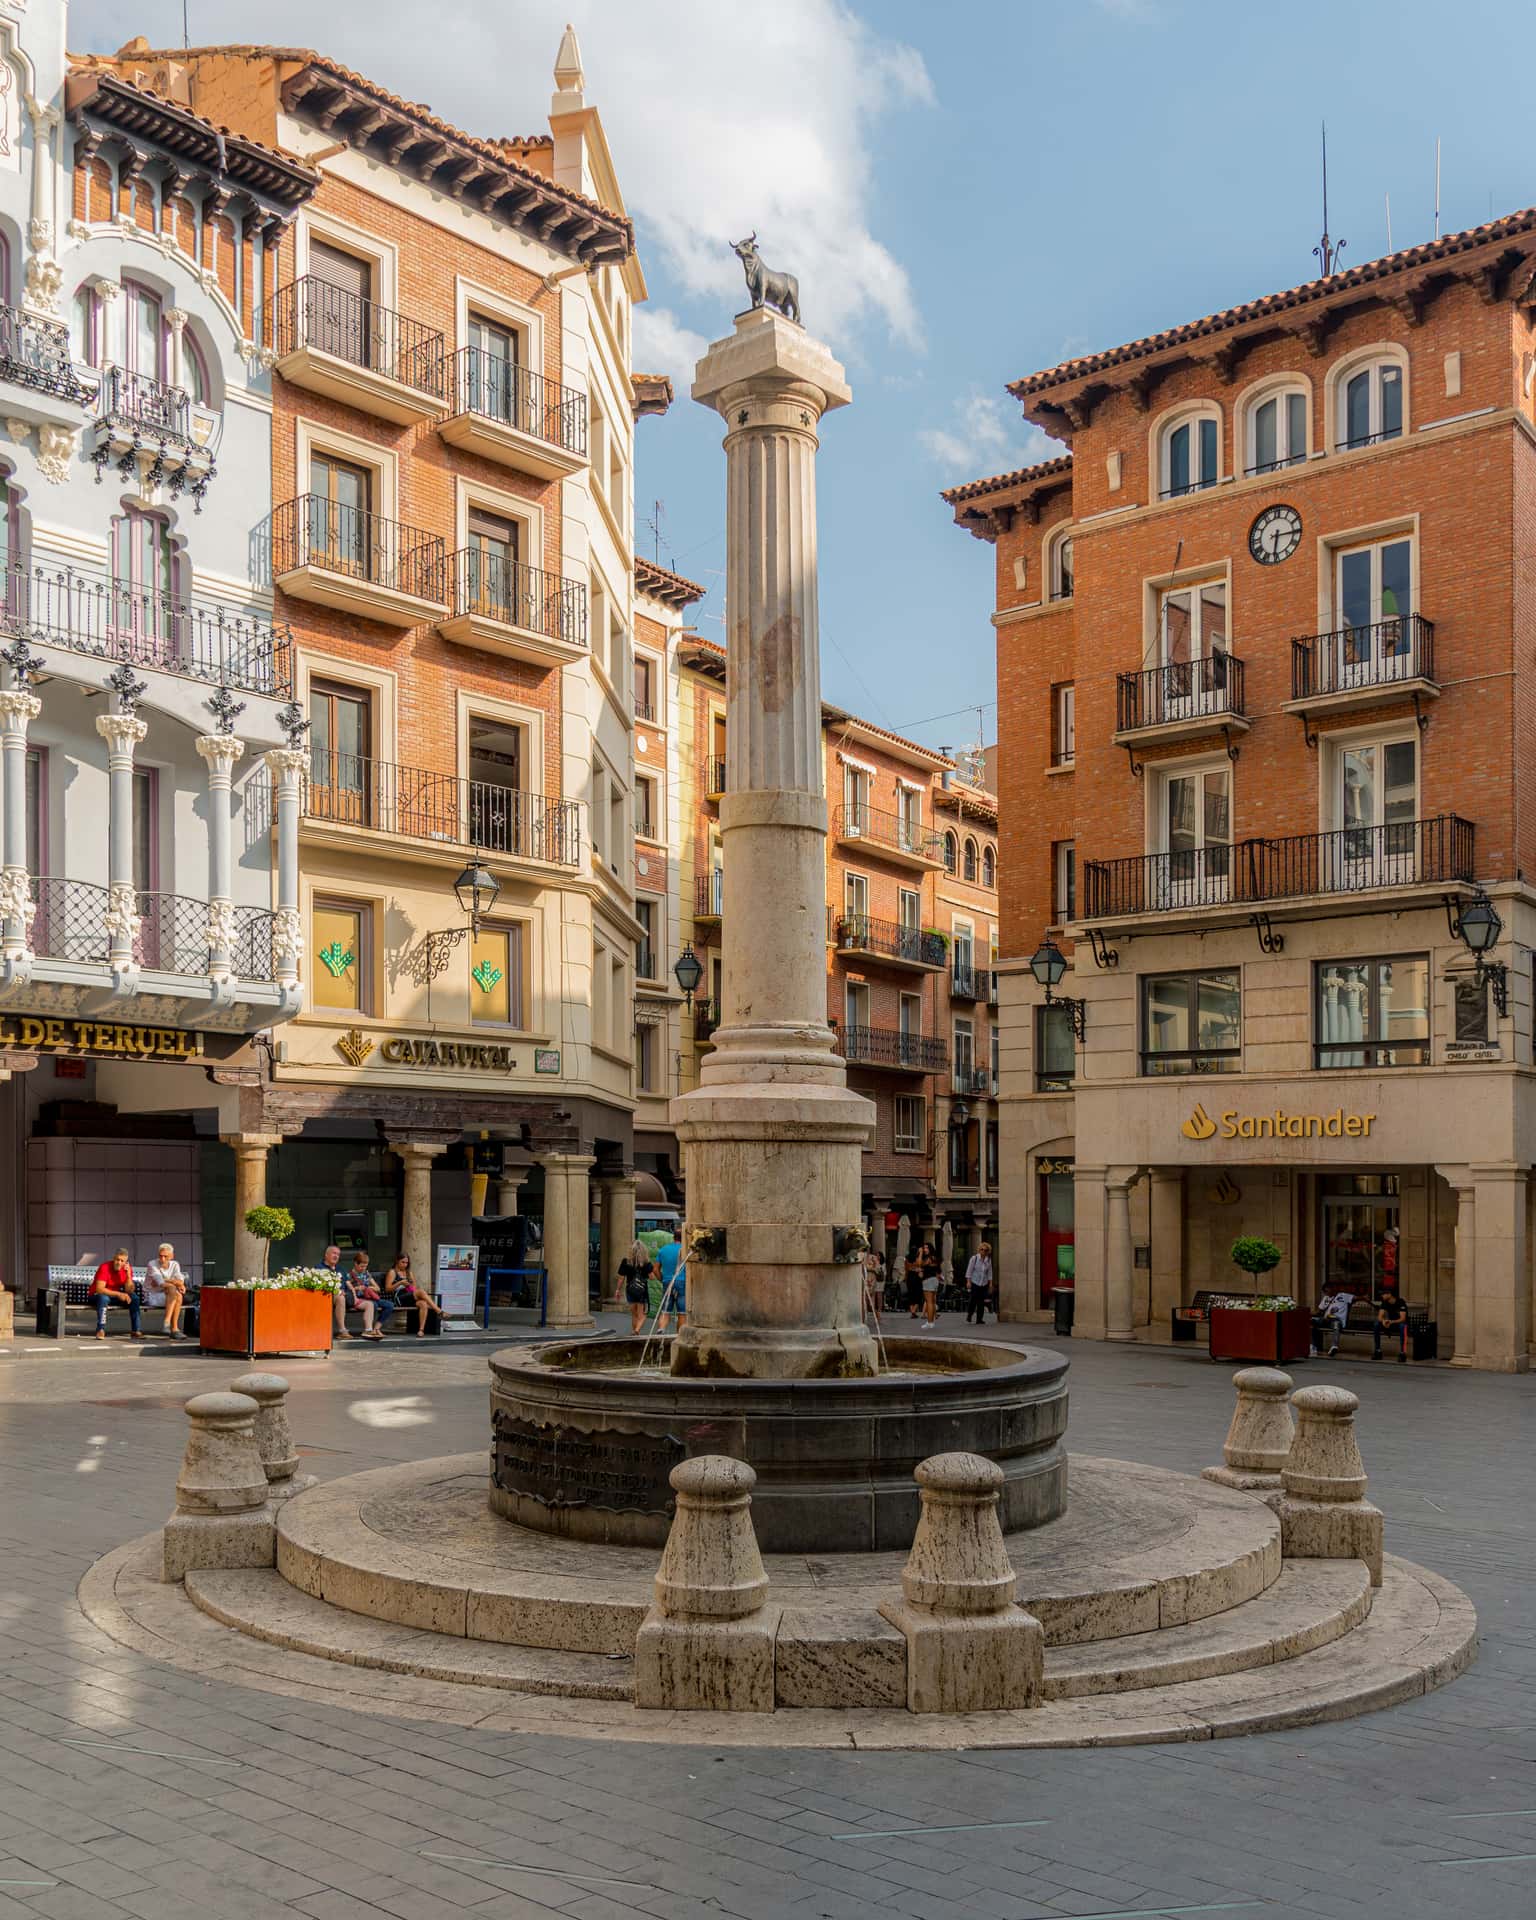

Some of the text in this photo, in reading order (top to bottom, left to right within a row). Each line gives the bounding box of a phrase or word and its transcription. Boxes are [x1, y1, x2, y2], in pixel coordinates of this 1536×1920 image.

[20, 1018, 65, 1046] DE
[73, 1022, 196, 1056] TERUEL
[1220, 1108, 1376, 1138] Santander
